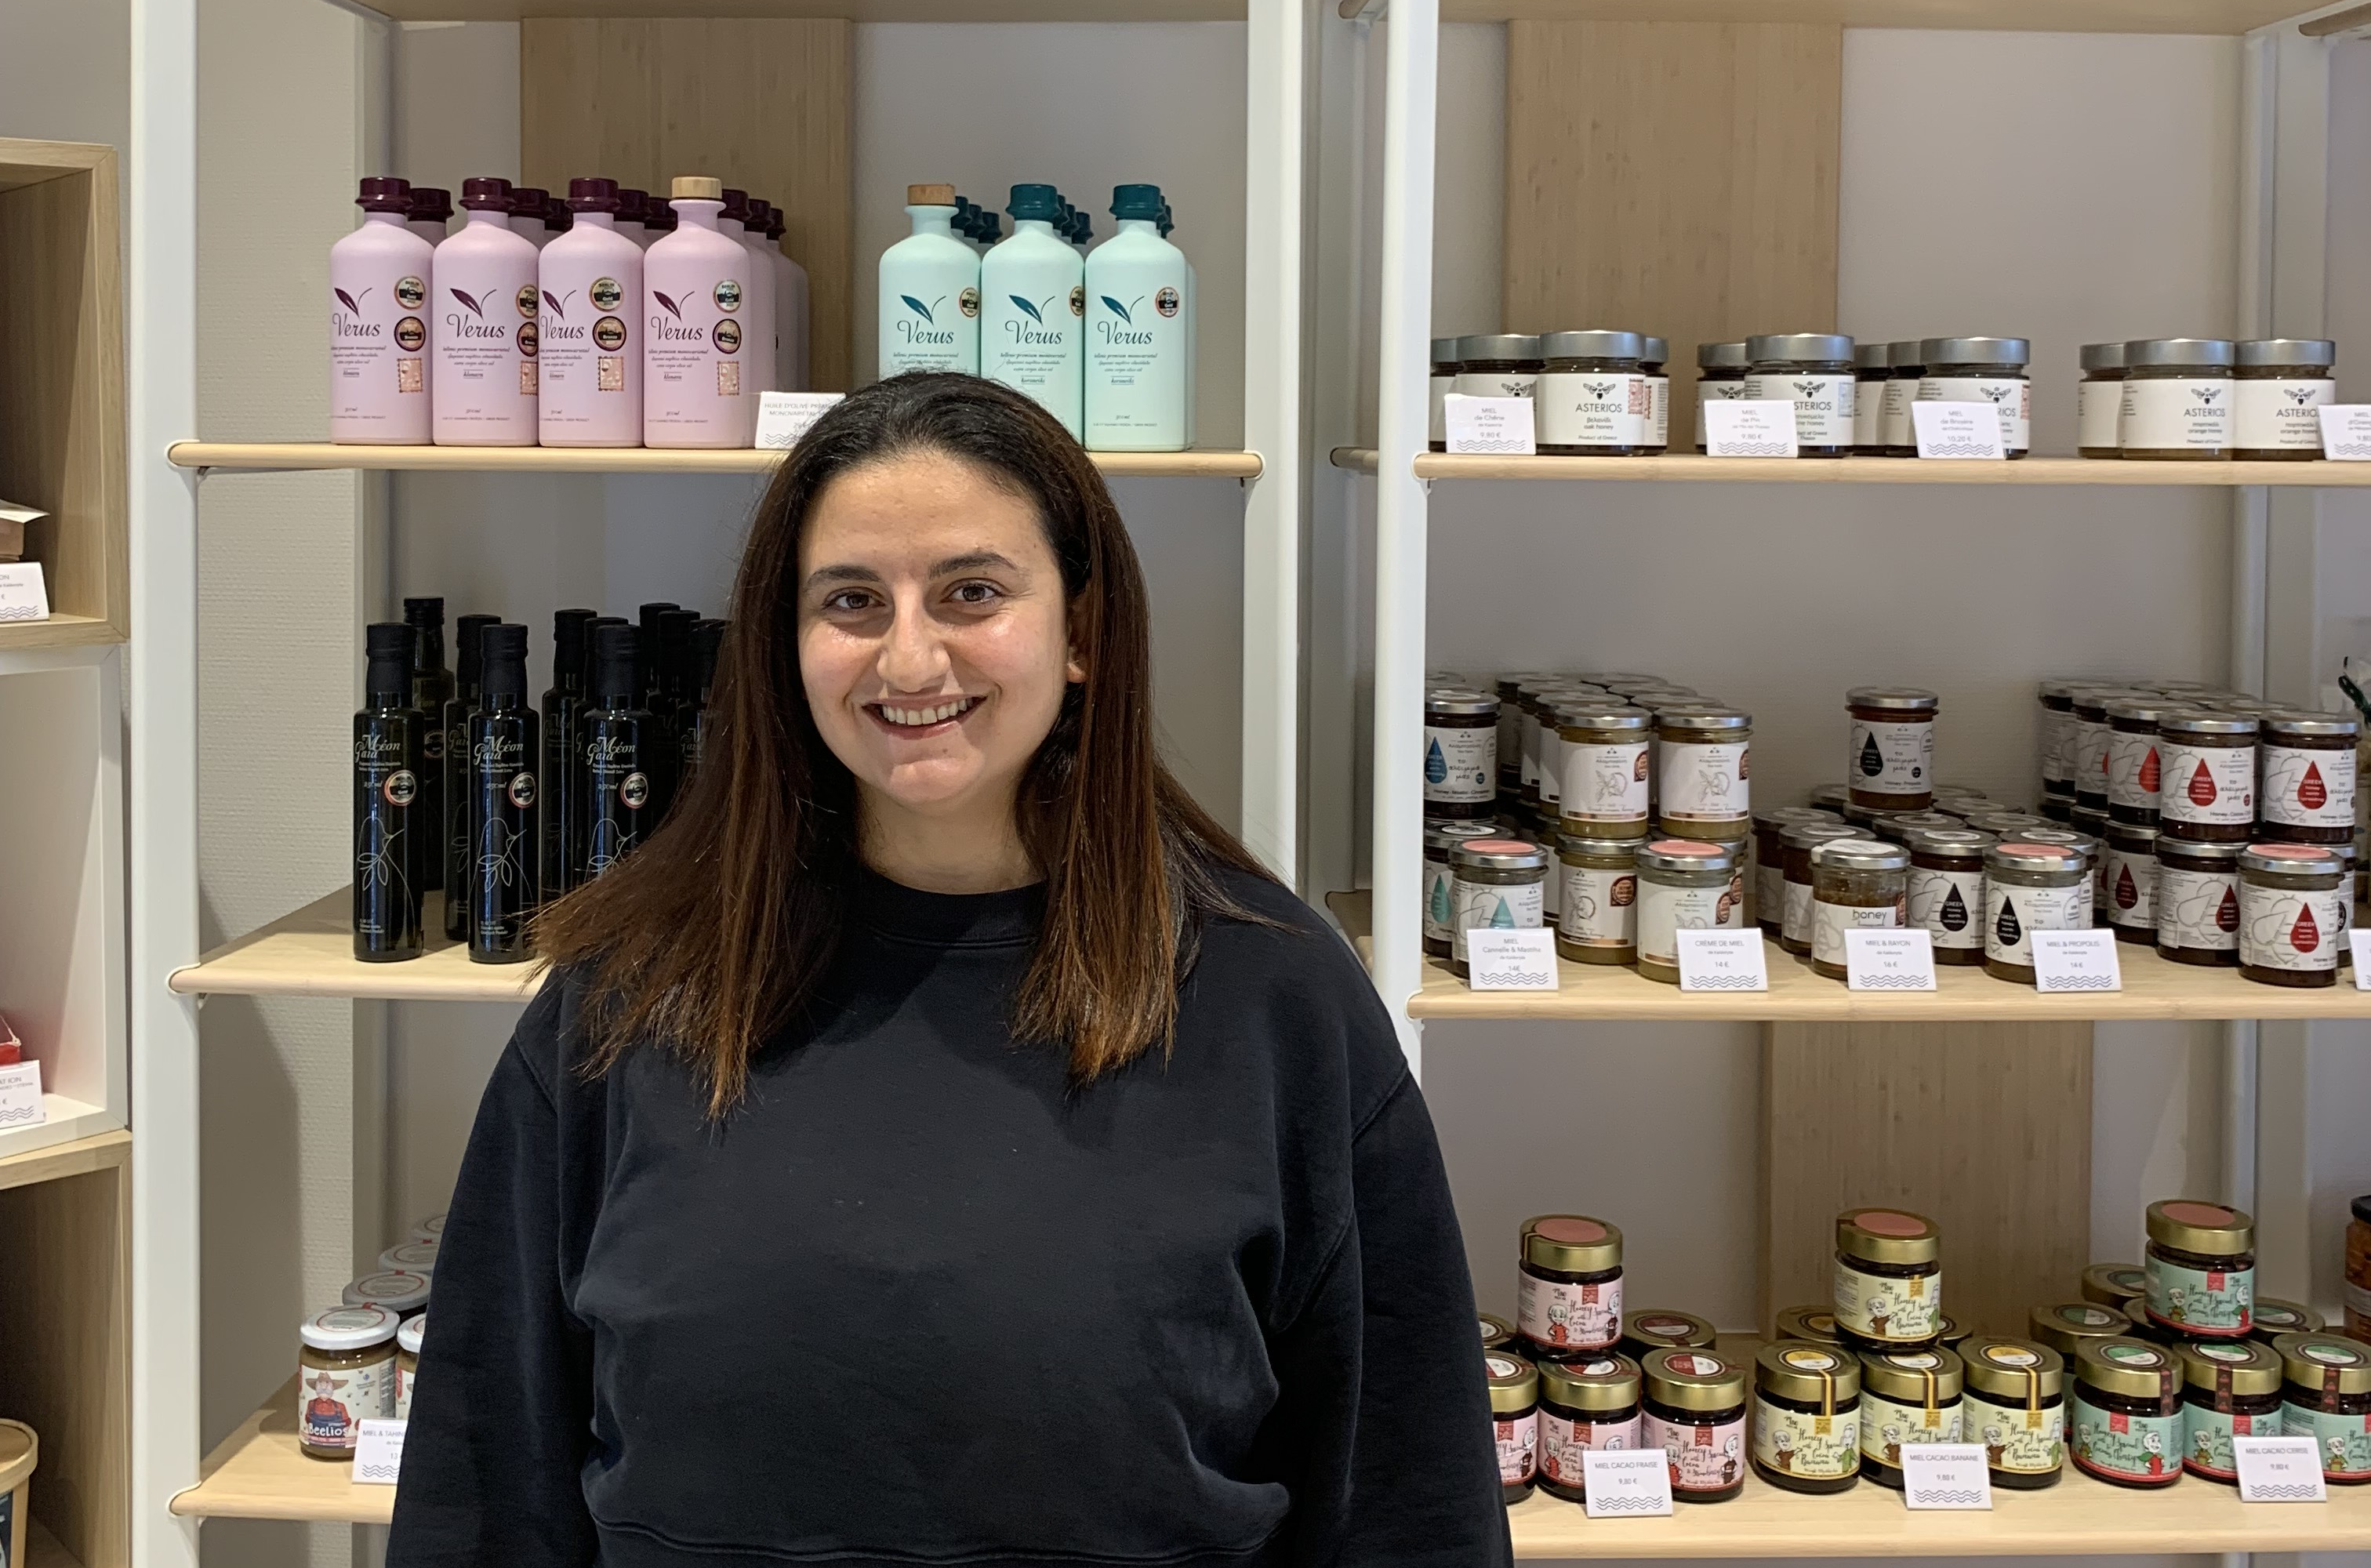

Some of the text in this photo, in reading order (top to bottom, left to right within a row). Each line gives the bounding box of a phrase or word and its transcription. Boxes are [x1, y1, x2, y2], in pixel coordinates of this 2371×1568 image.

[332, 313, 381, 338] Verus
[447, 314, 505, 339] Verus
[540, 315, 585, 339] Verus
[651, 316, 703, 341] Verus
[897, 320, 954, 344] Verus
[1004, 320, 1062, 344] Verus
[1098, 321, 1153, 345] Verus
[1575, 403, 1622, 412] ASTERIOS
[1793, 401, 1832, 411] STERIOS
[2184, 408, 2226, 418] ASTERIOS
[355, 741, 379, 764] Gaia
[362, 734, 401, 751] Méon
[483, 735, 523, 753] Méon
[597, 736, 636, 753] Méon
[473, 742, 502, 766] Gaia
[586, 743, 614, 766] Gaia
[1852, 909, 1886, 924] honey
[1893, 1293, 1916, 1312] Honey
[2188, 1283, 2213, 1305] Honey
[1568, 1300, 1592, 1319] Honey
[1798, 1428, 1822, 1450] Honey
[1908, 1421, 1932, 1443] Honey
[2010, 1422, 2034, 1443] Honey
[2094, 1421, 2116, 1446] Honey
[1680, 1440, 1707, 1464] Honey
[1801, 1454, 1829, 1466] Banana
